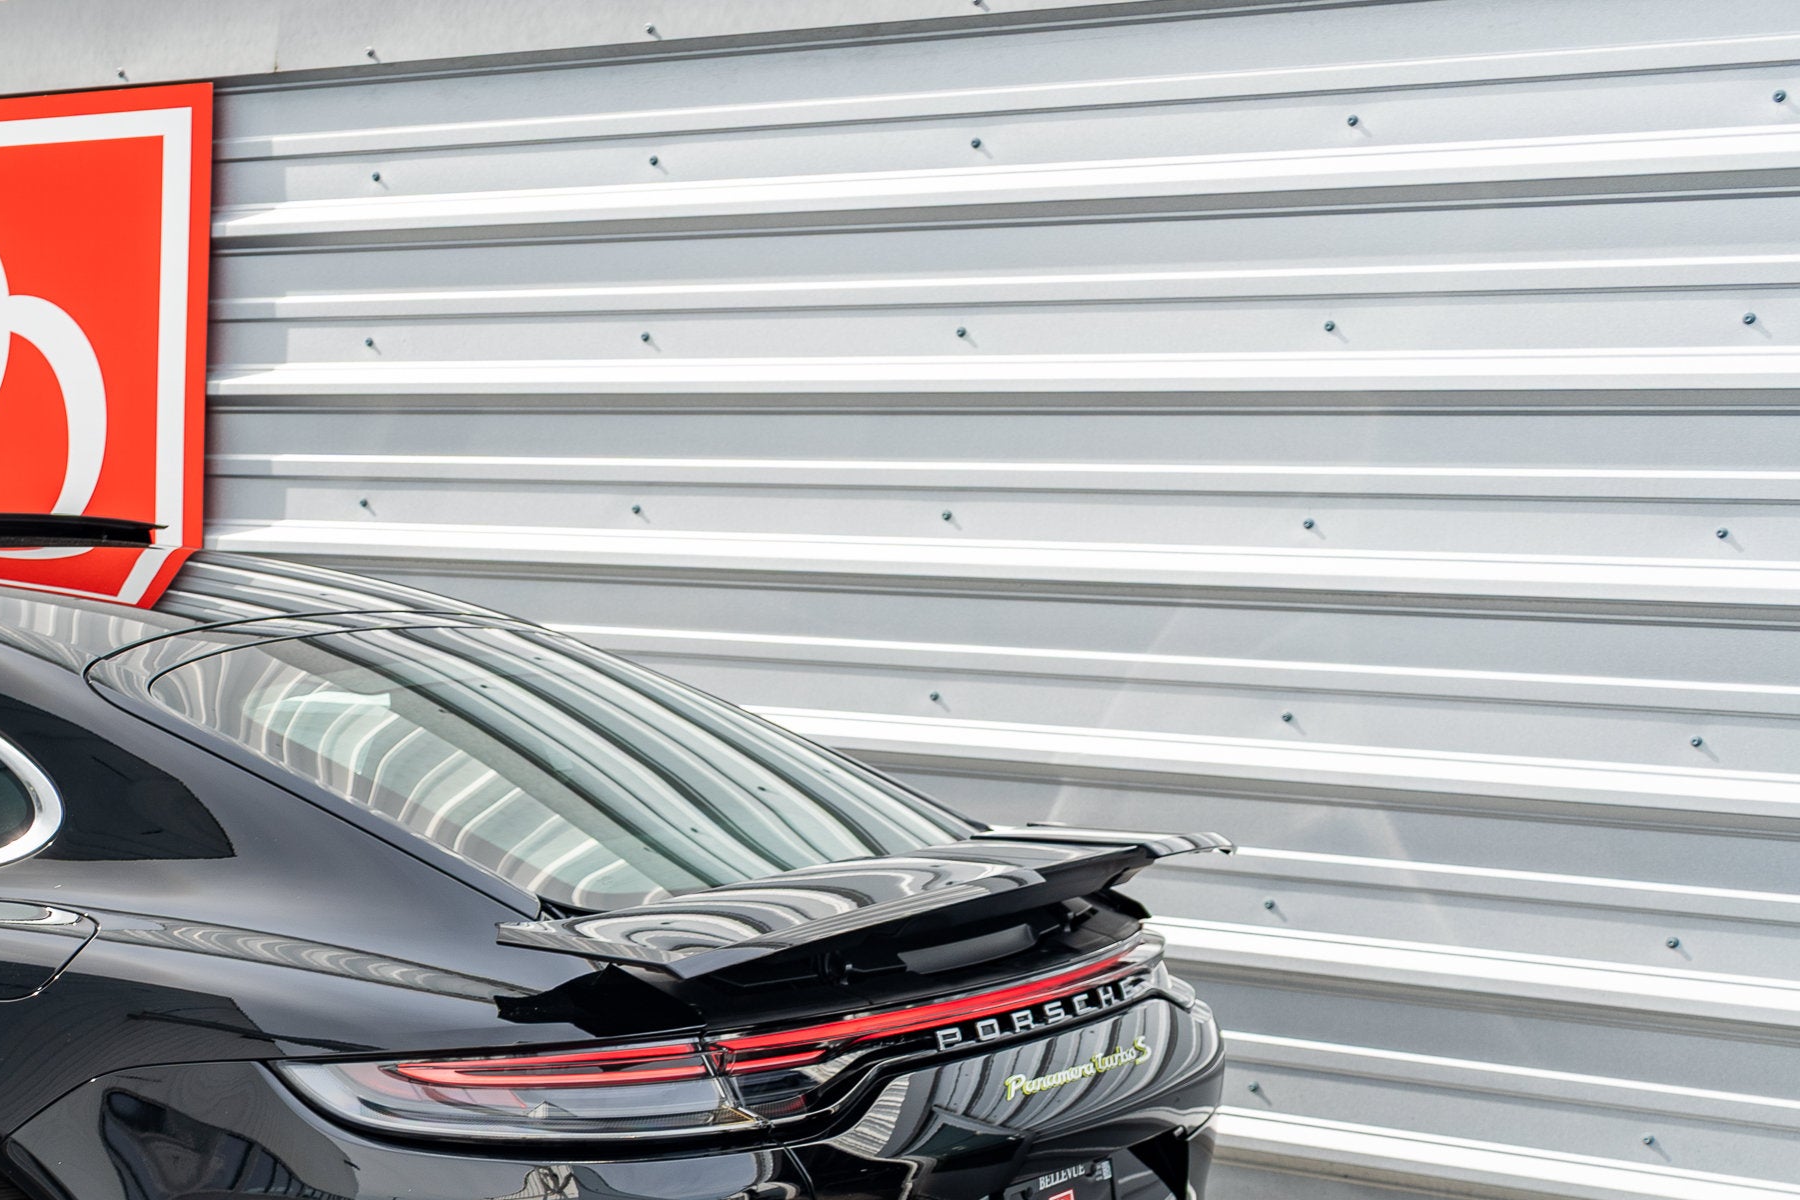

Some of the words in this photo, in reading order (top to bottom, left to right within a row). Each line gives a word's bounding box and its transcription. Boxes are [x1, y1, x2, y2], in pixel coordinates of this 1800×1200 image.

[935, 976, 1139, 1051] PORSCHE
[1004, 1061, 1096, 1101] Panamera
[1091, 1045, 1137, 1072] Turbo
[1133, 1035, 1152, 1065] S
[1038, 1164, 1086, 1191] BELLEVUE
